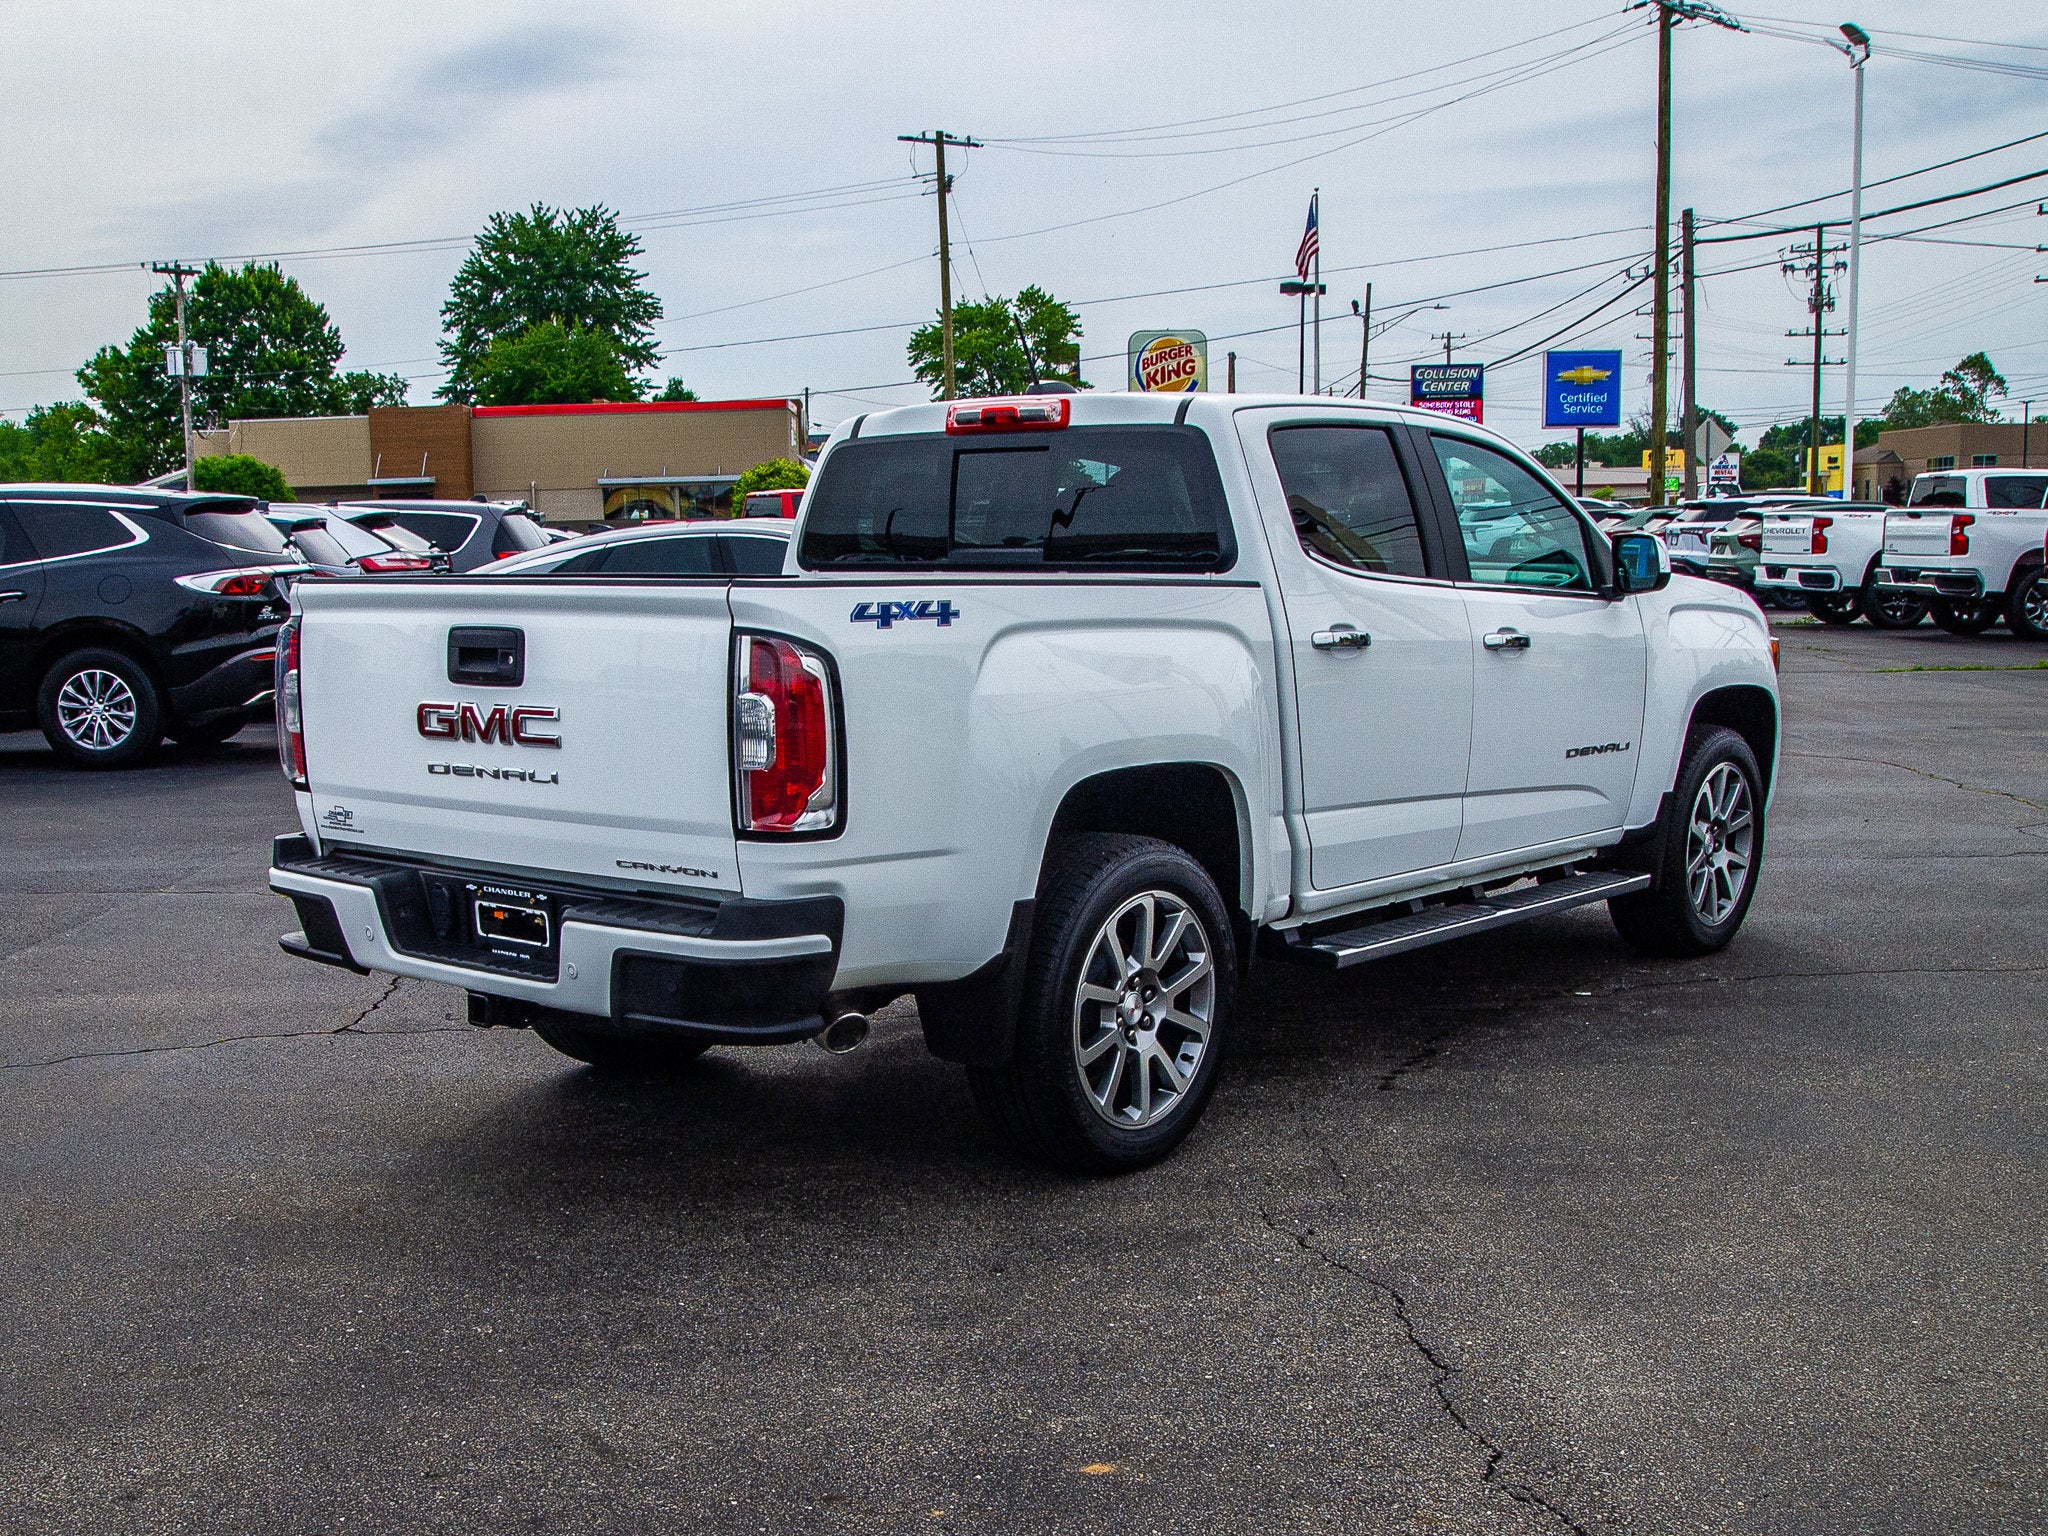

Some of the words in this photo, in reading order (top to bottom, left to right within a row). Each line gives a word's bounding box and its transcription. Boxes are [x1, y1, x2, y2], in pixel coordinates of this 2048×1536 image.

[1142, 345, 1193, 371] BURGER
[1146, 359, 1195, 390] KING
[1416, 368, 1479, 379] COLLISION
[1422, 381, 1470, 392] CENTER
[1560, 392, 1608, 403] Certified
[1563, 403, 1603, 414] Service
[850, 599, 960, 630] 4X4
[417, 700, 562, 749] GMC
[1565, 741, 1631, 759] DENALI
[427, 761, 559, 785] DENALI
[616, 860, 719, 879] CANYON
[483, 885, 531, 898] CHANDLER
